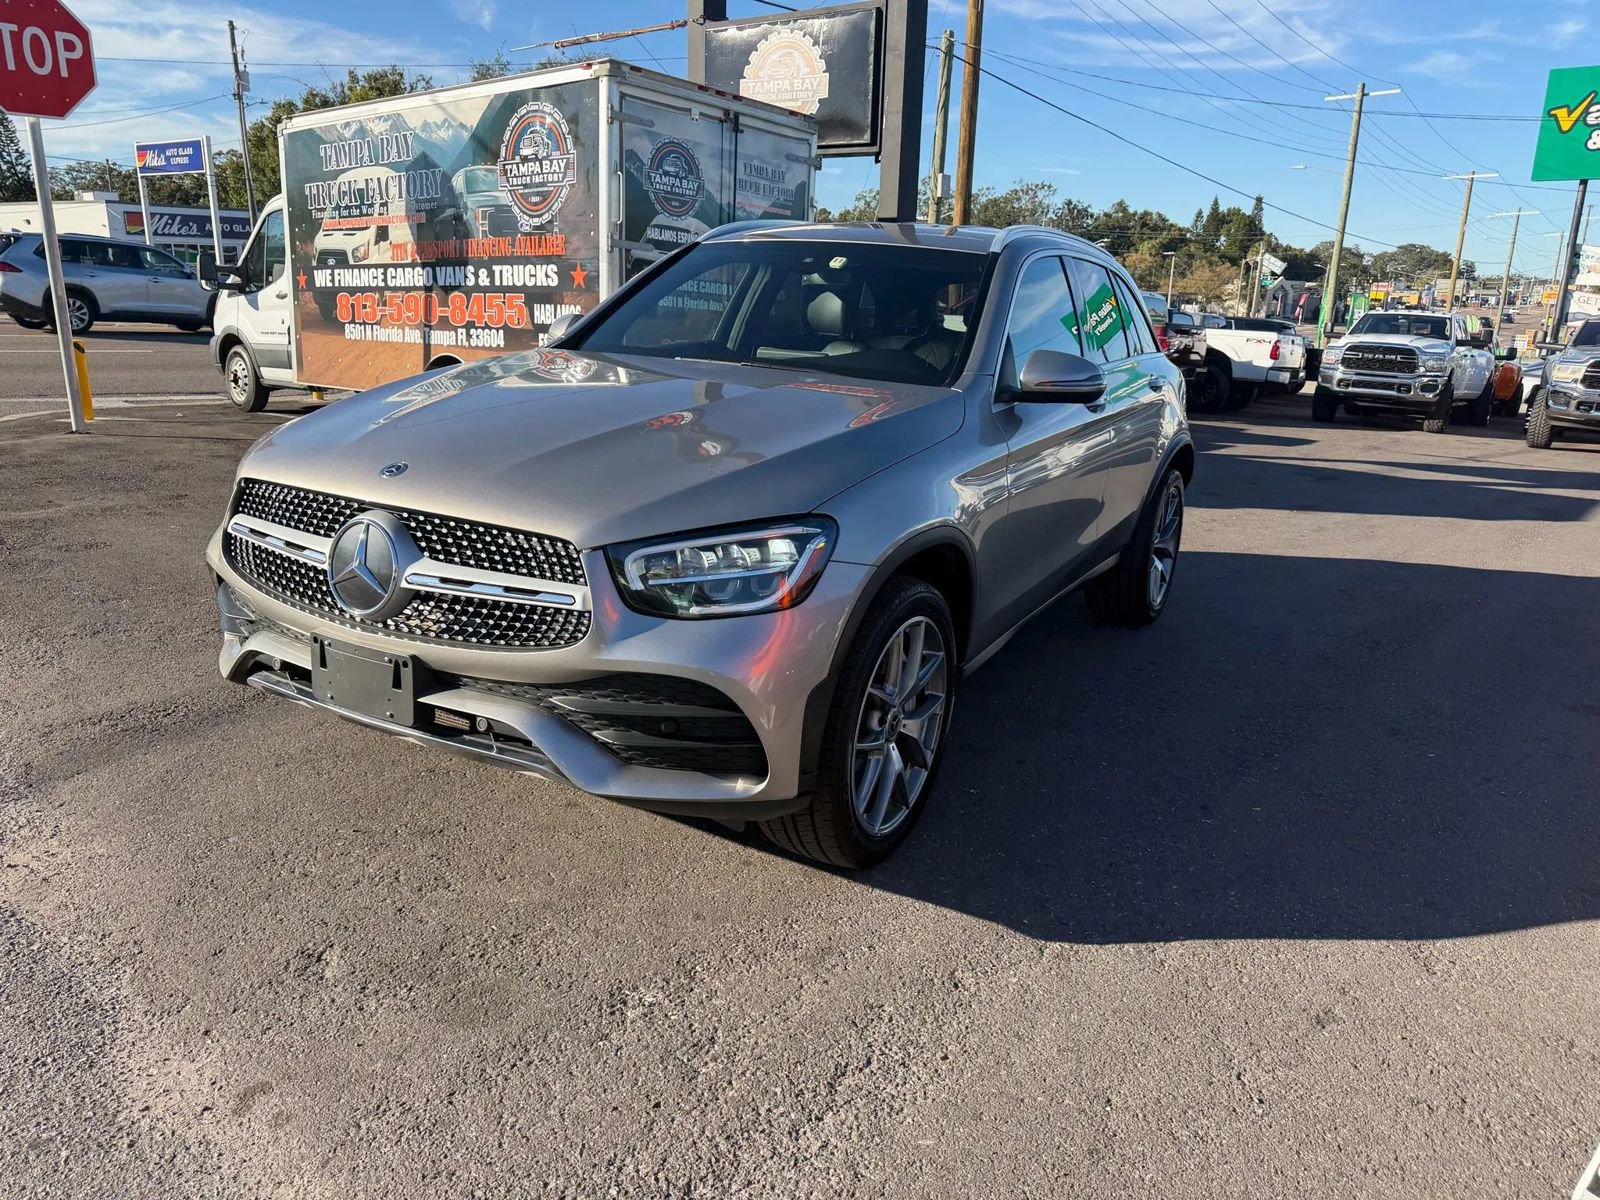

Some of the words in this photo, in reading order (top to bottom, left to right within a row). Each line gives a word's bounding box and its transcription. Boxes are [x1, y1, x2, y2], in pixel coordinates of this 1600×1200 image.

[0, 22, 84, 78] TOP
[748, 80, 791, 94] TAMPA
[795, 78, 821, 90] BAY
[144, 149, 167, 168] Mike's
[319, 138, 376, 172] TAMPA
[379, 130, 415, 164] BAY
[505, 161, 542, 178] TAMPA
[542, 158, 567, 174] BAY
[304, 179, 361, 210] TRUCK
[363, 168, 443, 204] FACTORY
[508, 176, 531, 186] TRUCK
[532, 173, 564, 184] FACTORY
[650, 172, 682, 188] TAMPA
[682, 179, 699, 191] BAY
[340, 207, 350, 218] for
[350, 206, 360, 217] the
[151, 214, 201, 236] Mike's
[205, 223, 231, 232] ATO
[232, 223, 252, 233] GLA
[647, 226, 677, 242] HABLAMOS
[677, 230, 699, 244] ESPAÑO
[463, 237, 513, 258] FINANCING
[313, 268, 333, 288] WE
[334, 267, 385, 288] FINANCE
[386, 266, 433, 288] CARGO
[435, 265, 476, 287] VANS
[478, 267, 491, 287] &
[492, 263, 559, 288] TRUCKS
[700, 280, 727, 296] CARGO
[336, 291, 527, 329] 813-590-8455
[344, 323, 366, 340] 8501
[366, 325, 373, 340] N
[373, 325, 402, 343] Florida
[404, 326, 423, 344] Ave.
[423, 327, 456, 347] Tampa
[469, 328, 505, 348] 33604
[1363, 352, 1397, 361] RAM
